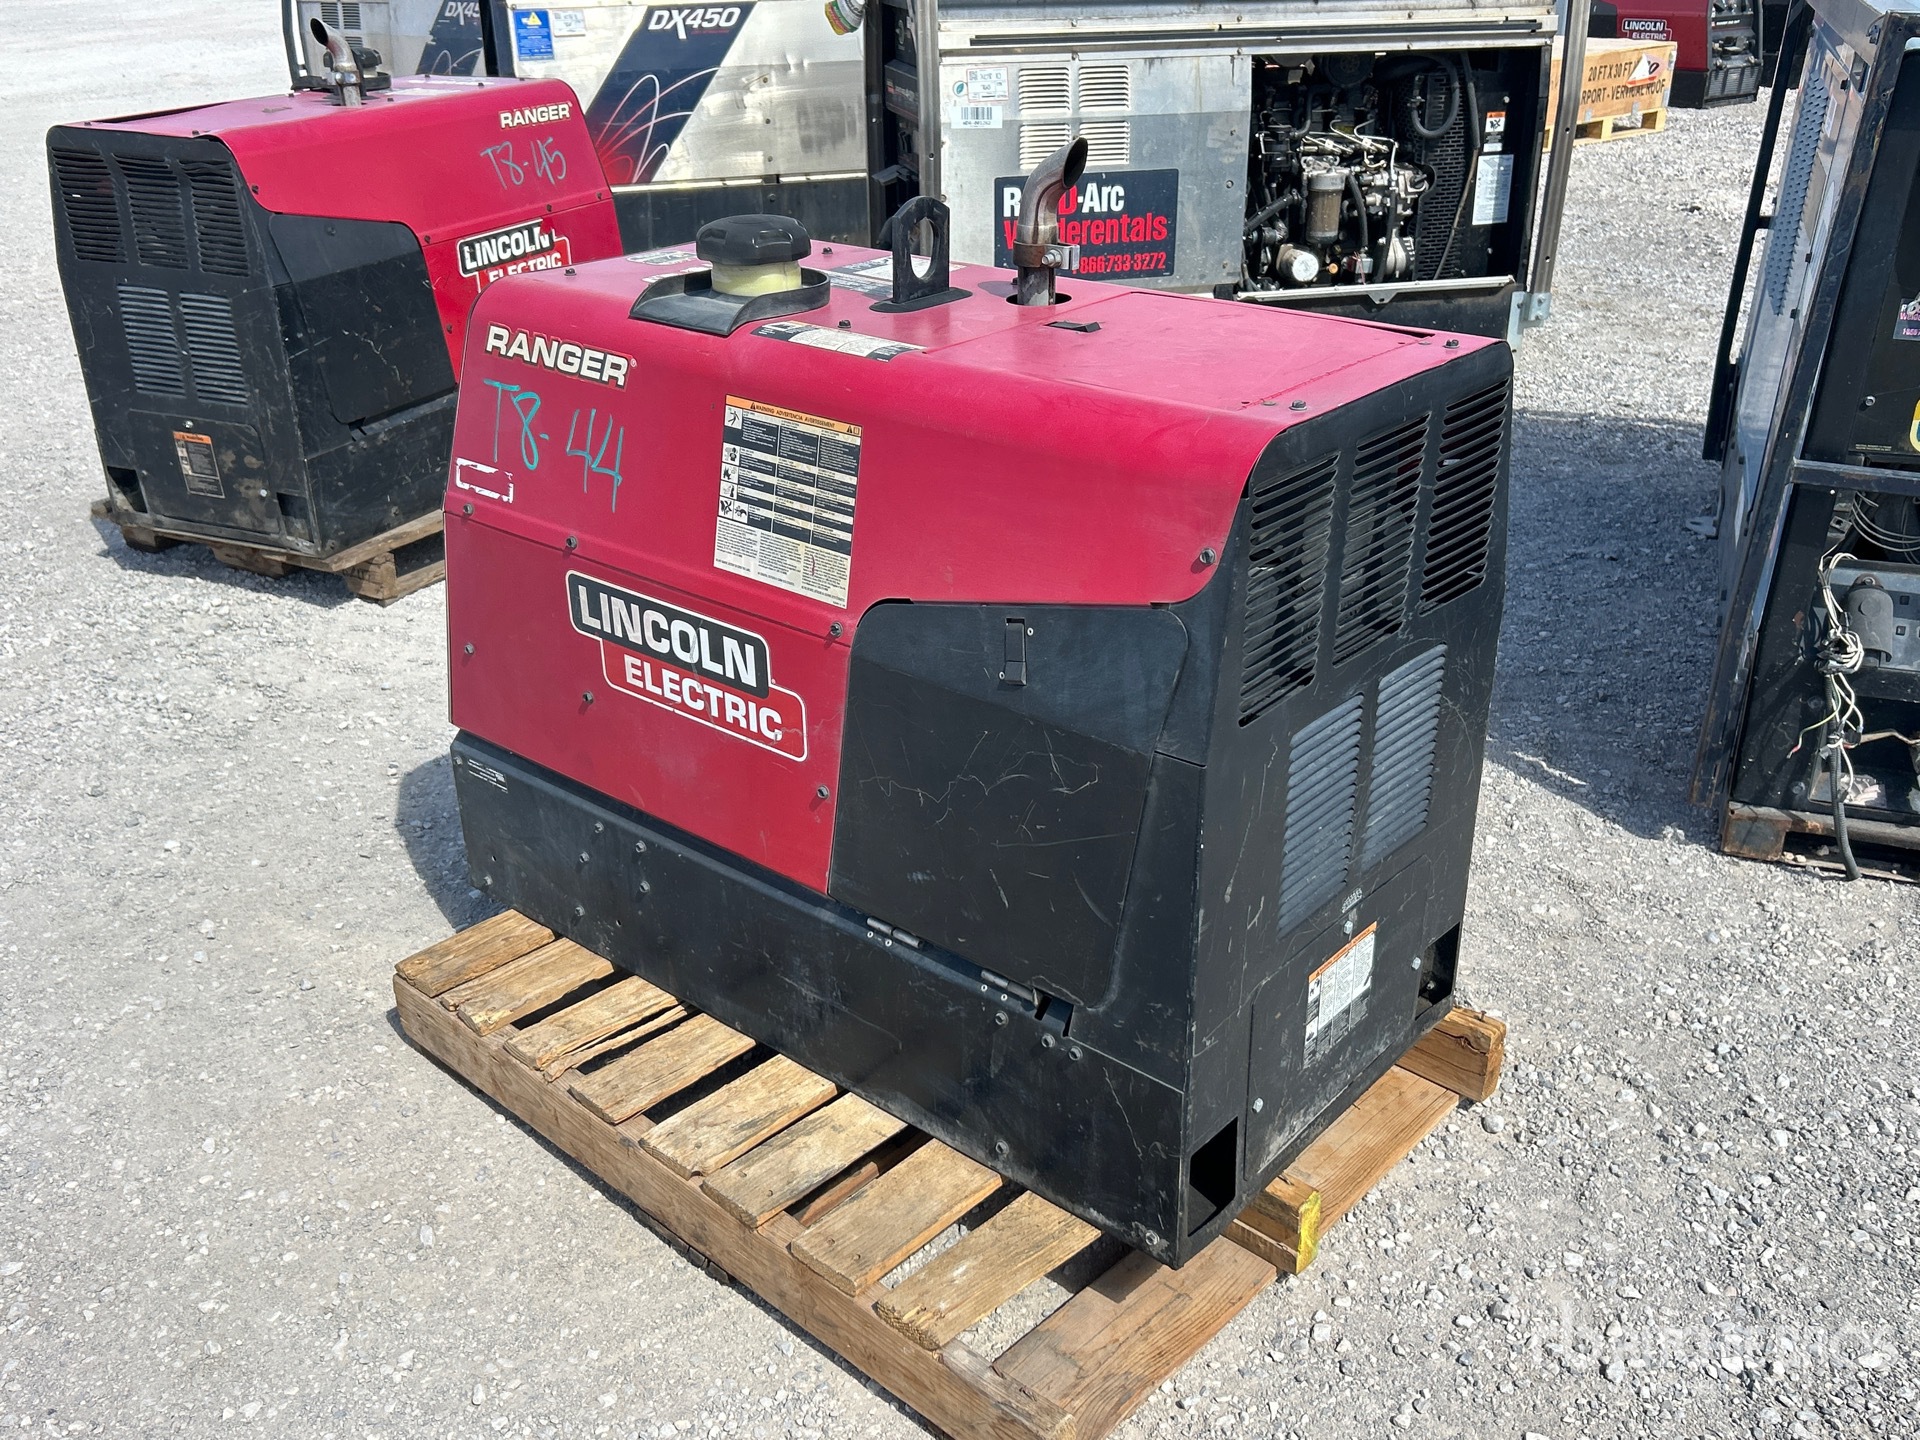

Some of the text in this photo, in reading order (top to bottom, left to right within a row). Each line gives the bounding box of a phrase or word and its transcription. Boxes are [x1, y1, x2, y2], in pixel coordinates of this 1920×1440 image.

[444, 1, 480, 26] DX45
[647, 7, 742, 40] DX450
[1624, 20, 1664, 31] LINCOLN
[1632, 32, 1667, 40] ELECTRIC
[500, 103, 571, 129] RANGER
[480, 136, 567, 190] T8-45
[463, 226, 550, 270] LINCOLN
[485, 324, 629, 387] RANGER
[483, 379, 624, 513] T8-44
[578, 584, 757, 688] LINCOLN
[624, 654, 784, 743] ELECTRIC
